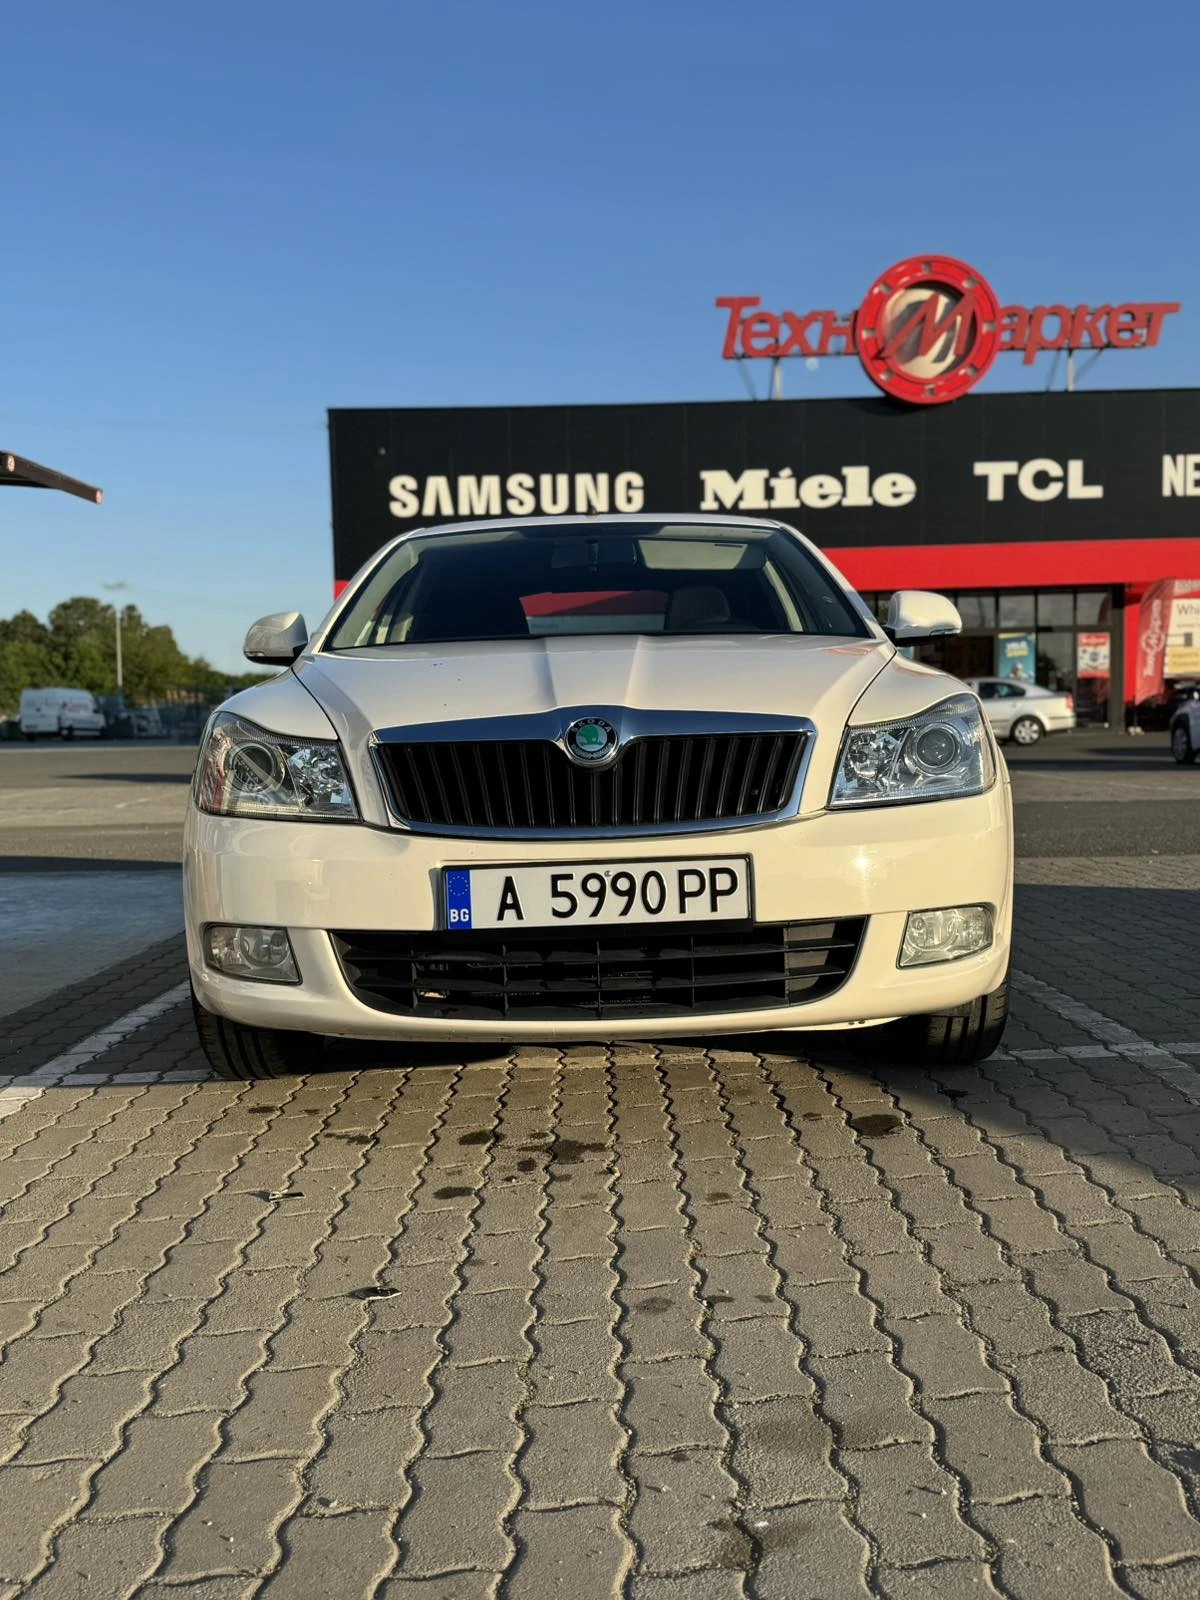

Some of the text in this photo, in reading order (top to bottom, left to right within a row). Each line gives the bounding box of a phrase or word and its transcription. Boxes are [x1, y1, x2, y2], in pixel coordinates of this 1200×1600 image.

[388, 471, 645, 518] SAMSUNG
[700, 465, 917, 511] Miele
[973, 458, 1103, 501] TCL
[449, 909, 469, 922] BG
[497, 867, 738, 921] A 5990 PP
